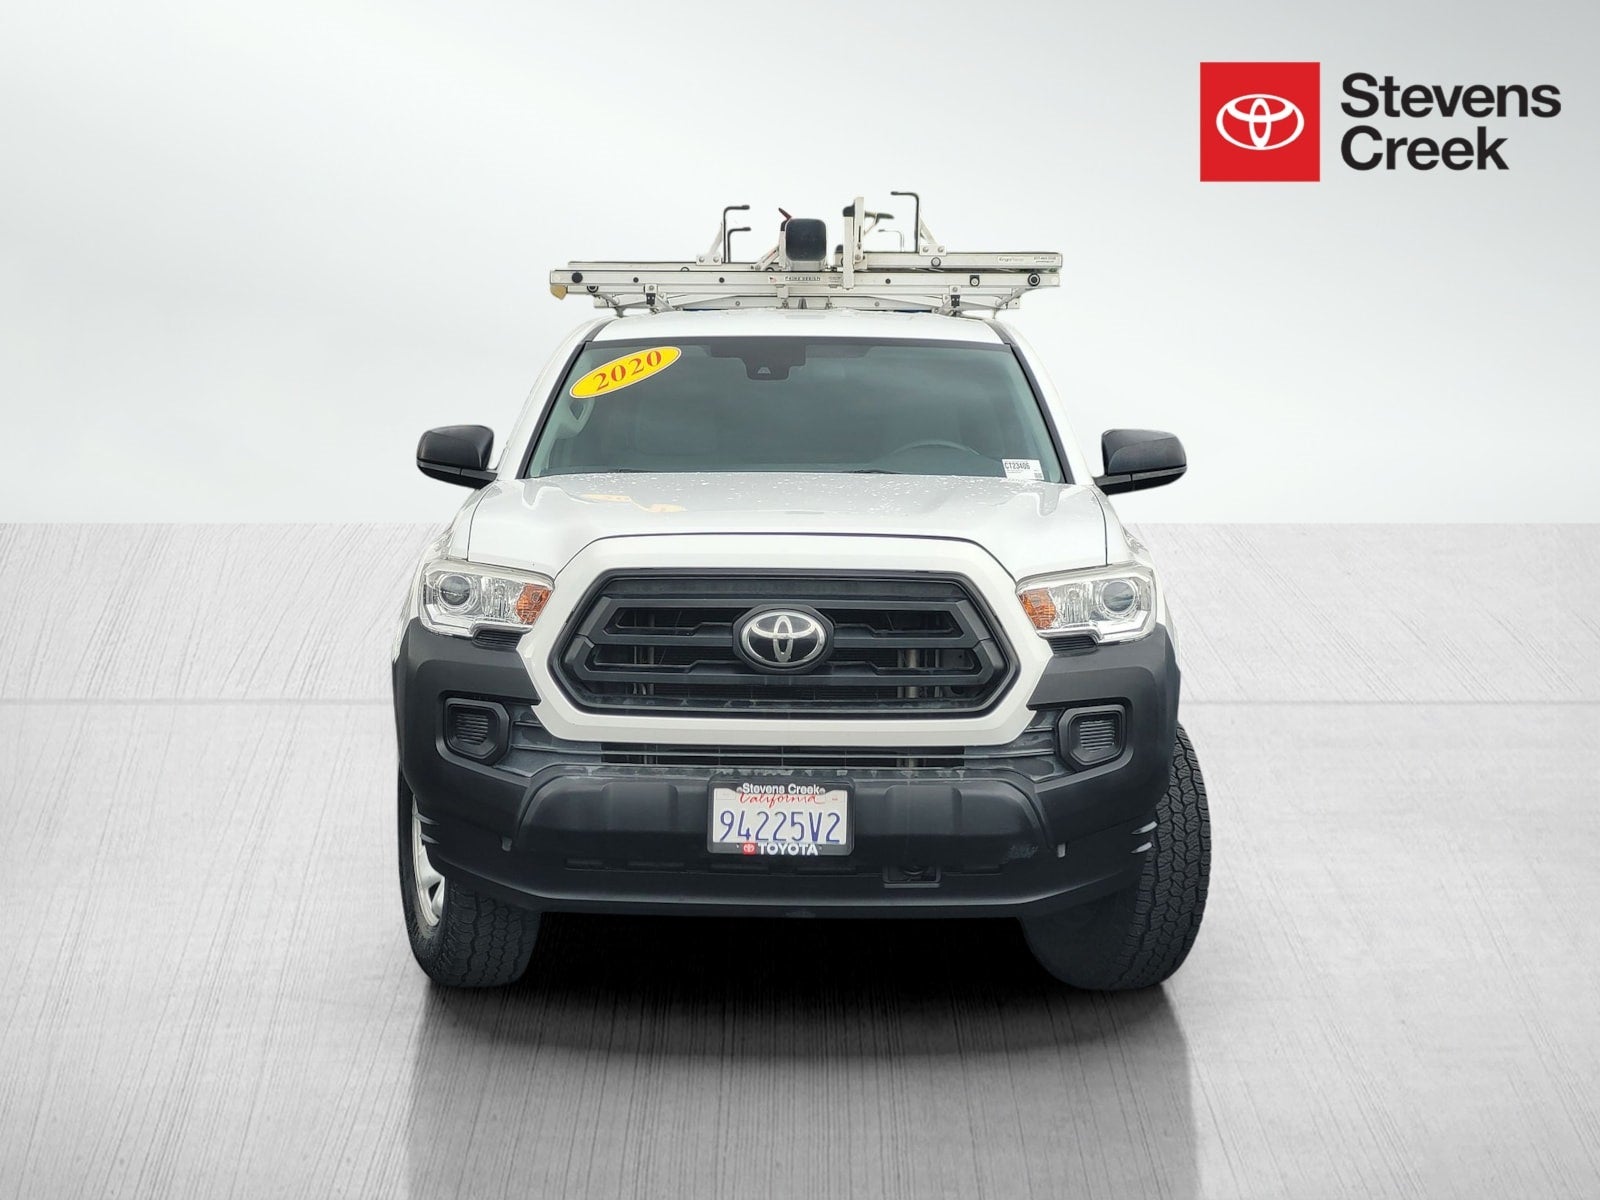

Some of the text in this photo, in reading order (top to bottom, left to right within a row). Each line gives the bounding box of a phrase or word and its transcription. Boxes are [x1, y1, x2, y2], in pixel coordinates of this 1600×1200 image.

[593, 350, 662, 391] 2020
[742, 783, 820, 795] Stevens Creek
[739, 792, 826, 808] California
[720, 810, 841, 843] 94225V2
[758, 844, 819, 856] TOYOTA
